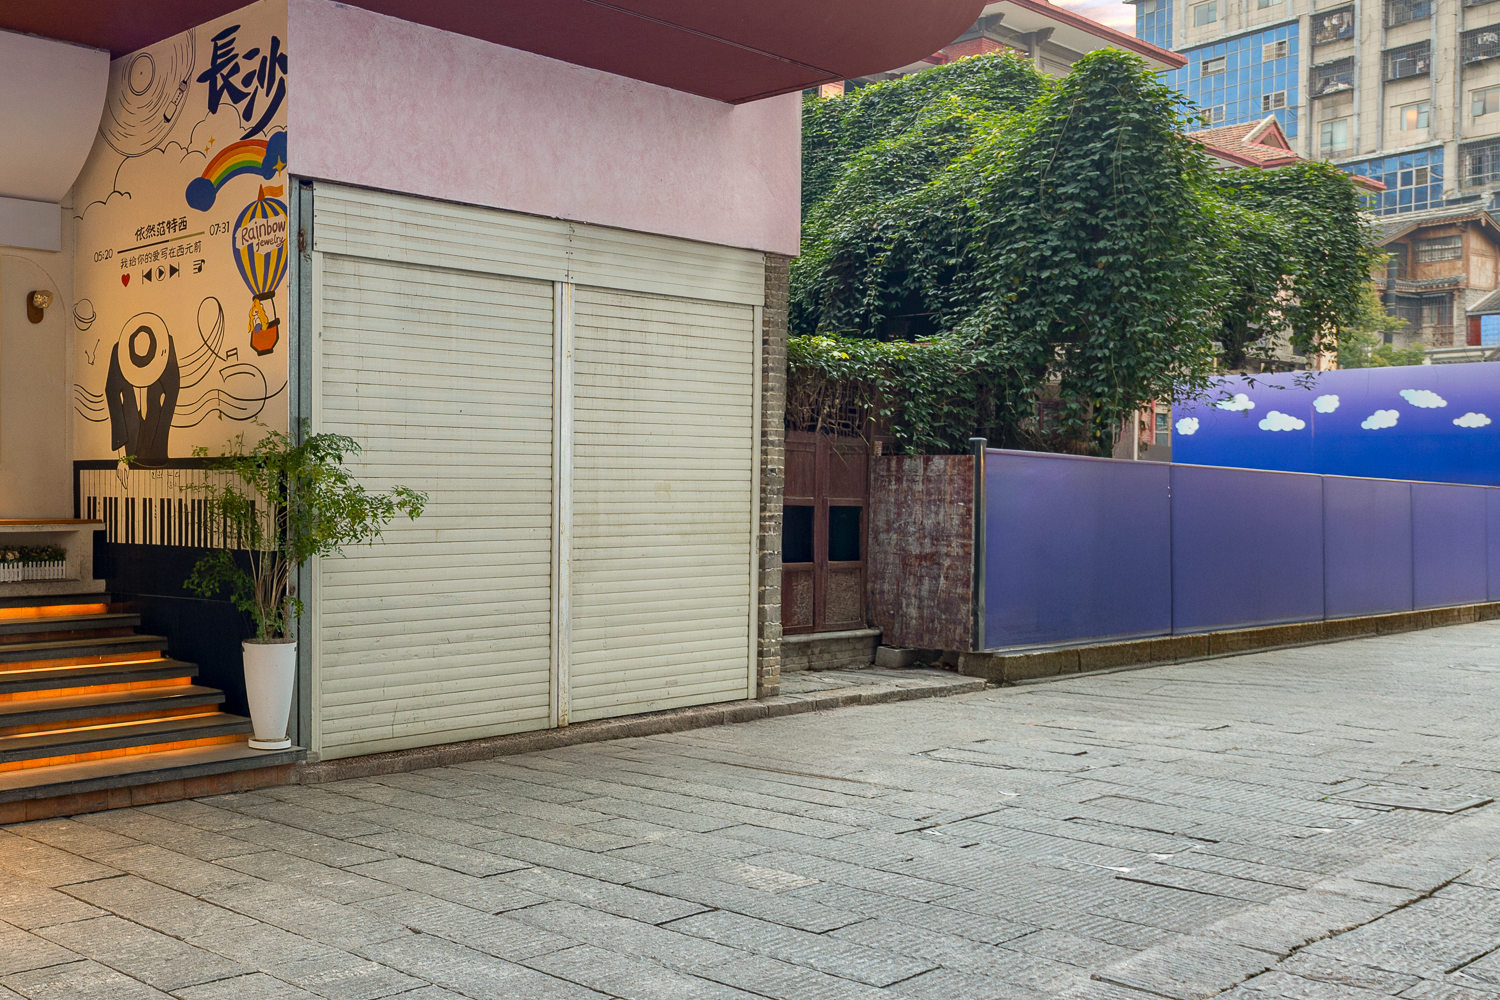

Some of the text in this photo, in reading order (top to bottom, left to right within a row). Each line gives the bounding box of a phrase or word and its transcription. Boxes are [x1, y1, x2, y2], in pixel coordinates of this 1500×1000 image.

[134, 216, 188, 242] 依然范特西
[209, 221, 230, 236] 07:31
[241, 219, 286, 246] Rainbow
[255, 234, 286, 252] jewelry
[93, 249, 113, 263] 05:20
[120, 240, 202, 270] 我给你的爱写在西元前
